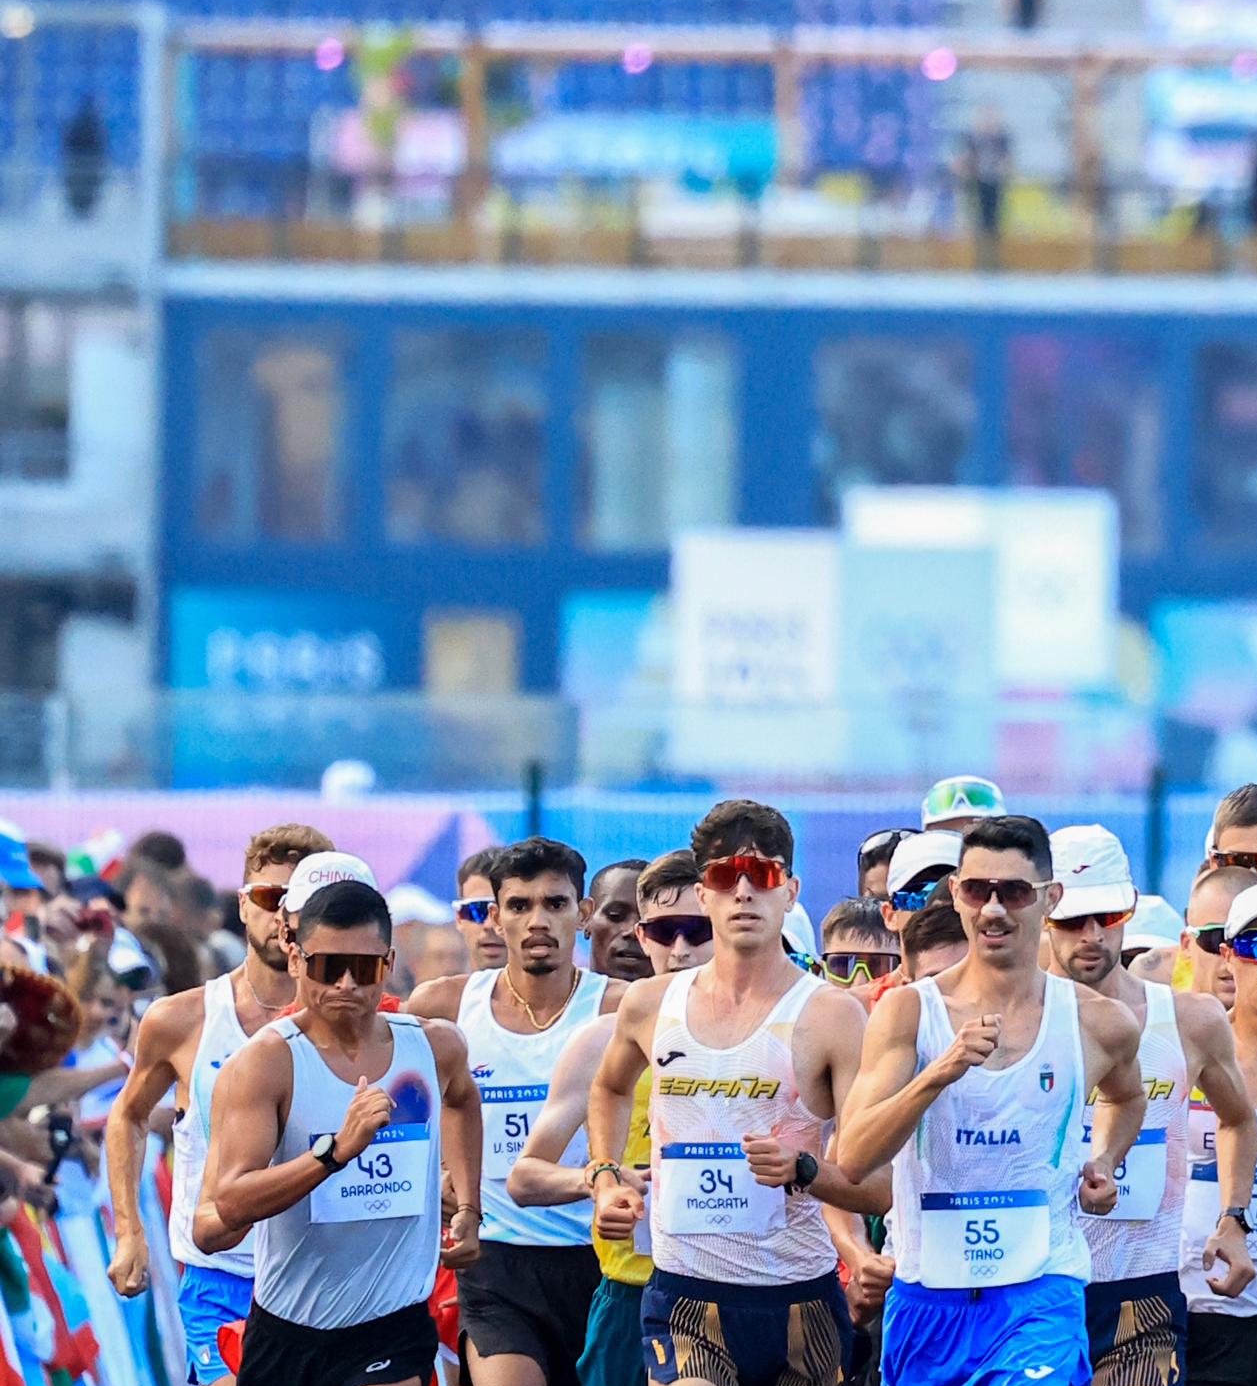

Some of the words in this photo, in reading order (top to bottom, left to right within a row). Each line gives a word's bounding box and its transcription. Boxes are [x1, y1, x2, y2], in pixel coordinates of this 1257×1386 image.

[484, 1090, 514, 1100] PARIS
[517, 1088, 546, 1098] 2024
[659, 1077, 781, 1099] ESPAÑA
[504, 1112, 530, 1138] 51
[375, 1130, 405, 1140] 2024
[956, 1129, 1021, 1145] ITALIA
[506, 1141, 525, 1153] SIN
[685, 1146, 714, 1156] PARIS
[718, 1146, 739, 1156] 202
[357, 1153, 393, 1179] 43
[341, 1180, 412, 1198] BARRONDO
[700, 1169, 733, 1194] 34
[949, 1197, 979, 1206] PARIS
[983, 1195, 1013, 1205] 2024
[964, 1220, 1000, 1245] 55
[964, 1249, 1004, 1261] STANO
